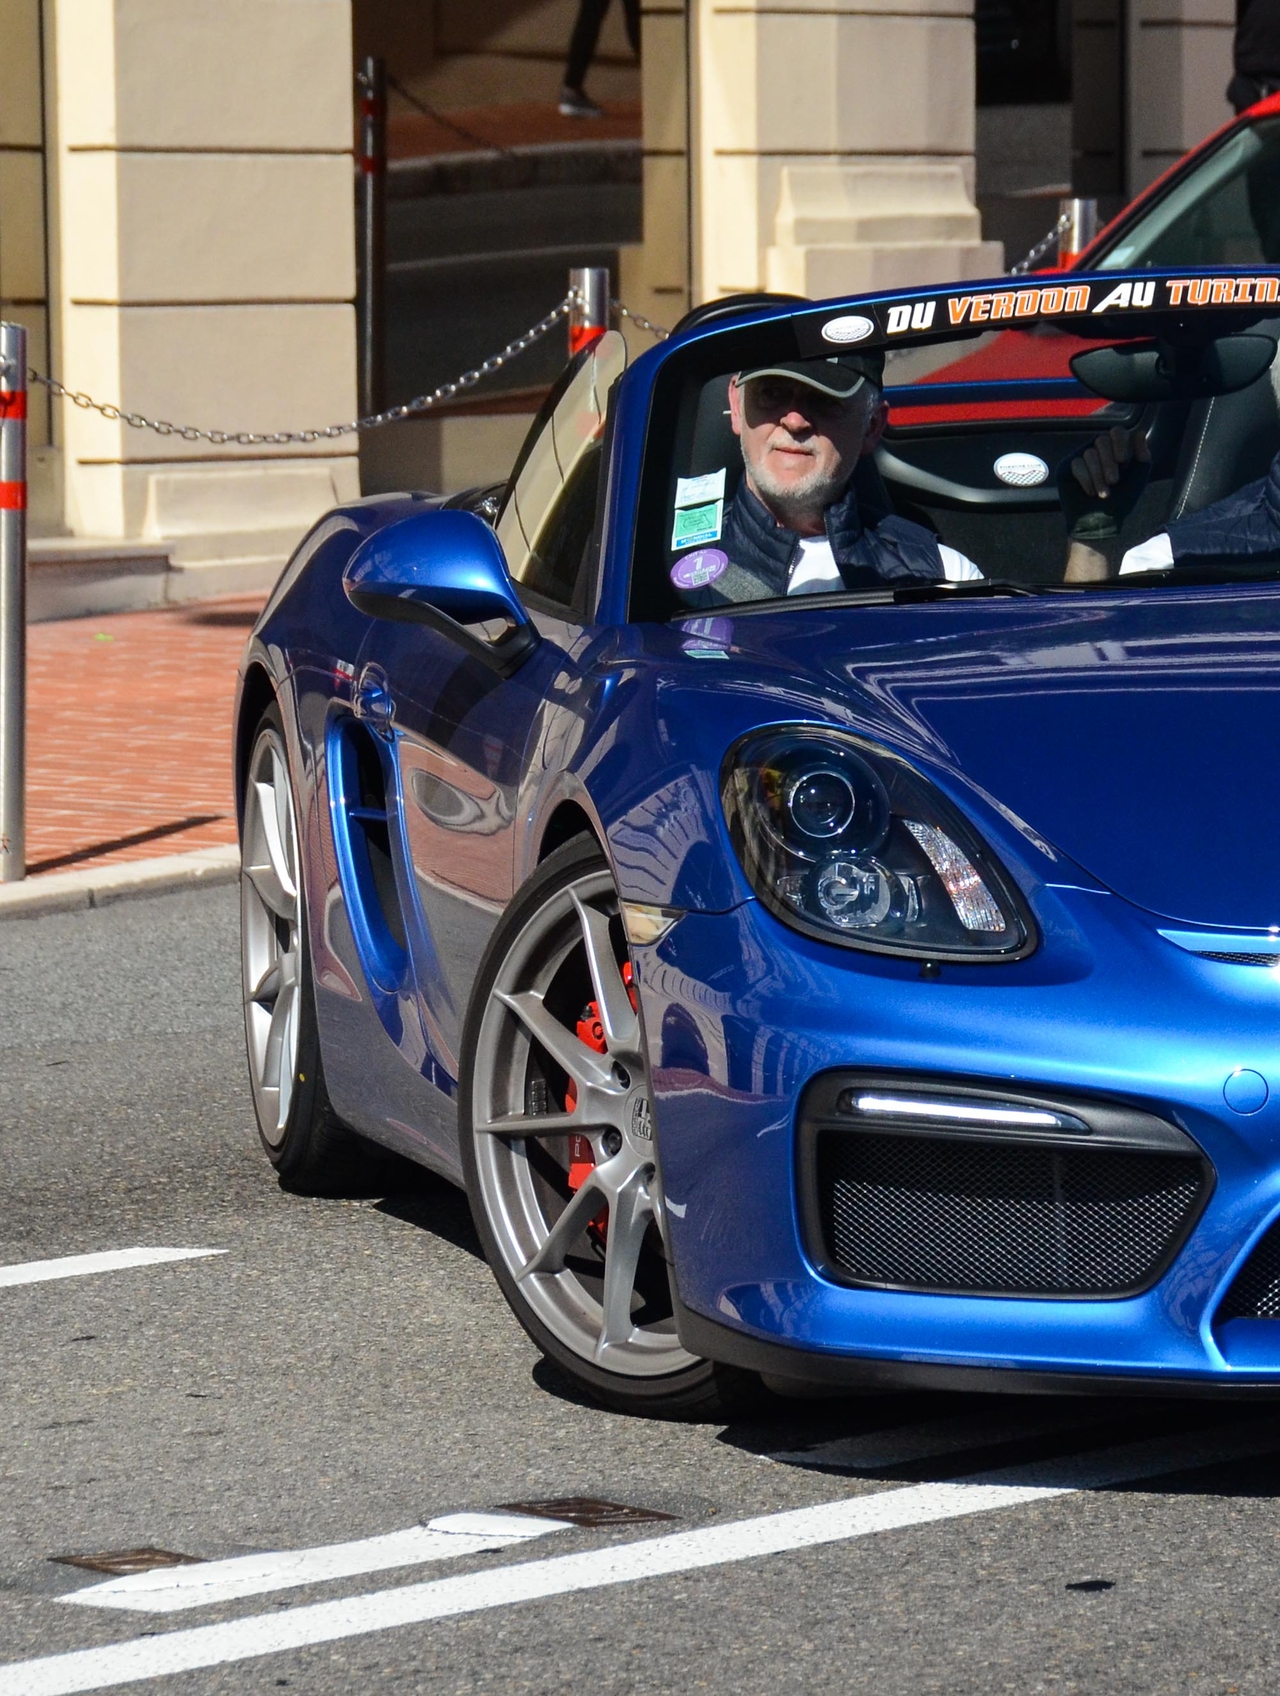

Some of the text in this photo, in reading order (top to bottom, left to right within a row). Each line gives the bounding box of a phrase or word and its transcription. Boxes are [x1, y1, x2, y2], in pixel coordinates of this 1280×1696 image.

[886, 300, 937, 334] DU
[947, 284, 1091, 325] VERDON
[1092, 280, 1156, 313] AU
[693, 556, 703, 570] 1
